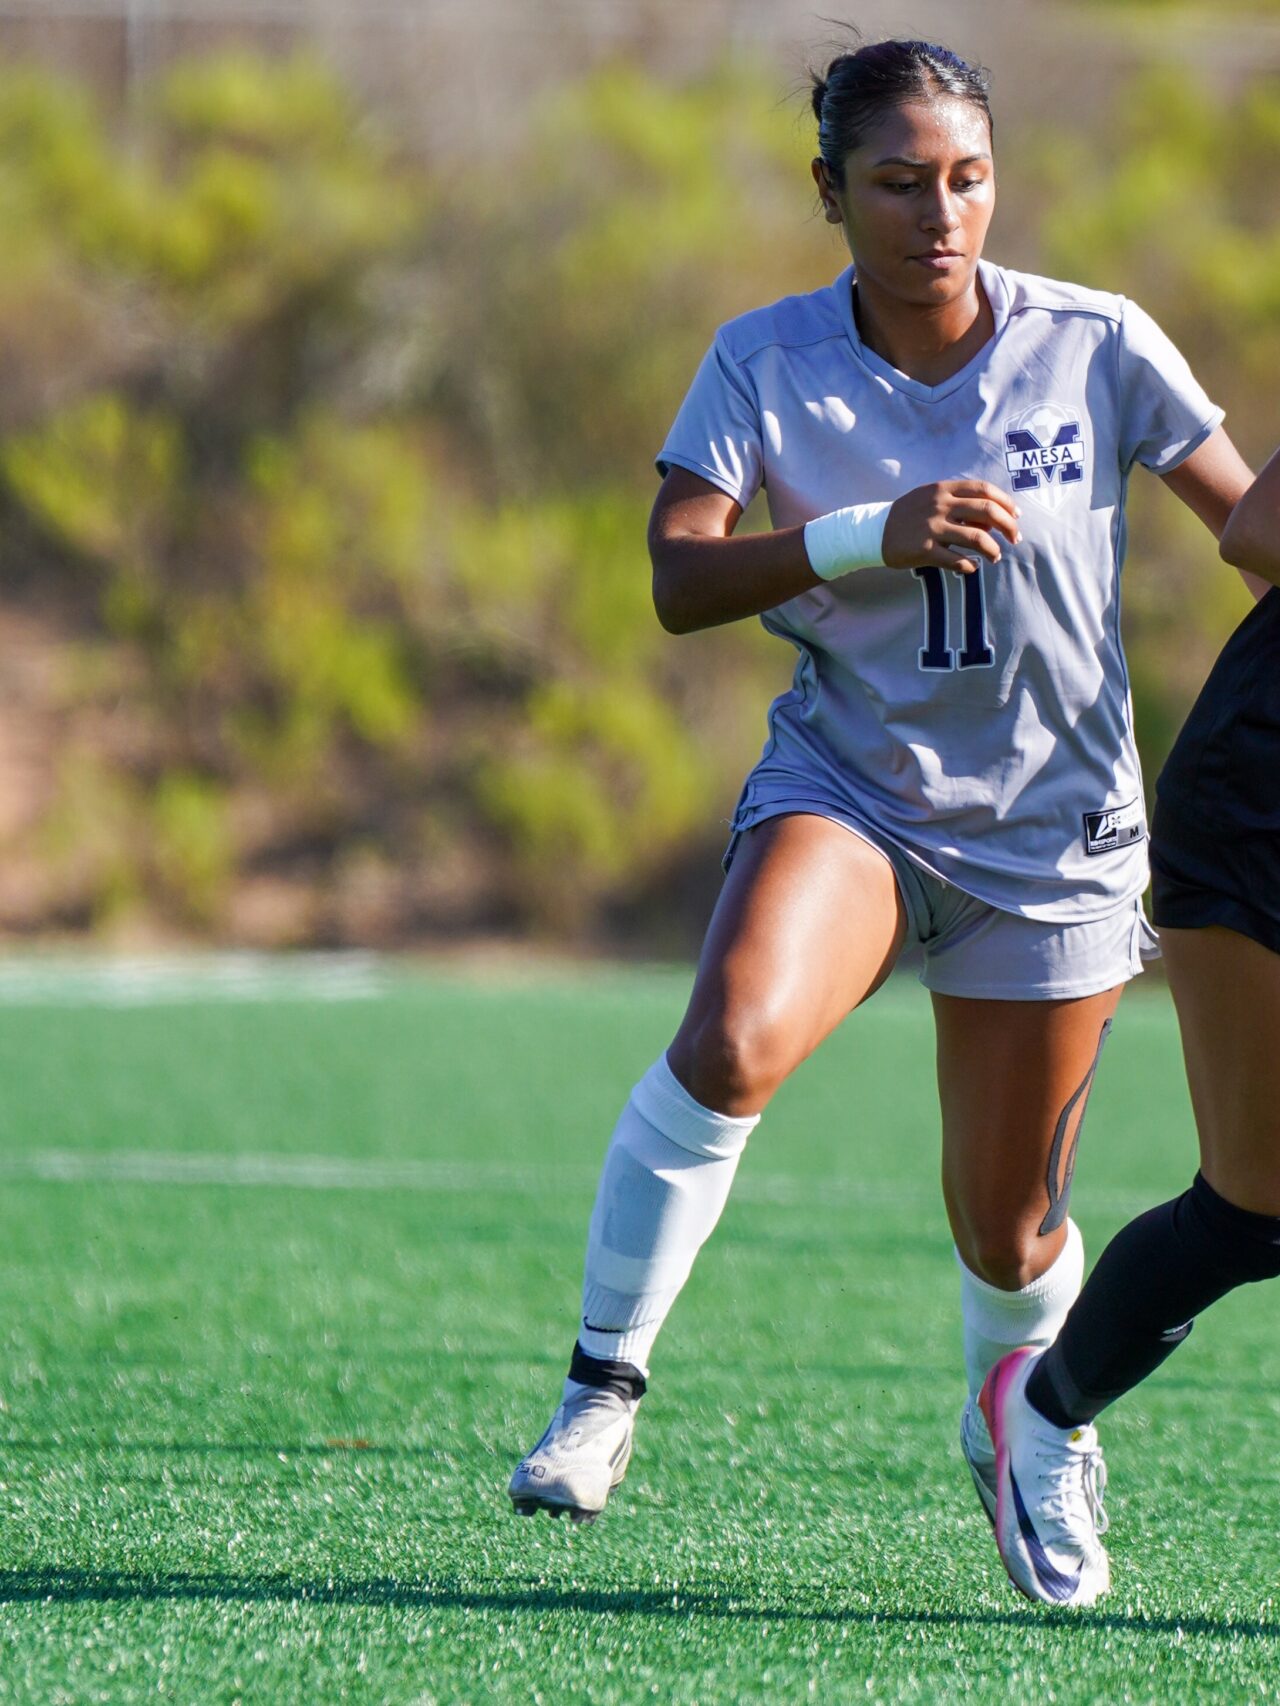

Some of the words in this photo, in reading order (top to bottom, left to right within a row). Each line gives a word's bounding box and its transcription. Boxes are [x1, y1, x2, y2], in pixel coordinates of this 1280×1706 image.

[1022, 446, 1073, 468] MESA
[910, 555, 996, 673] 11
[1129, 825, 1140, 839] M
